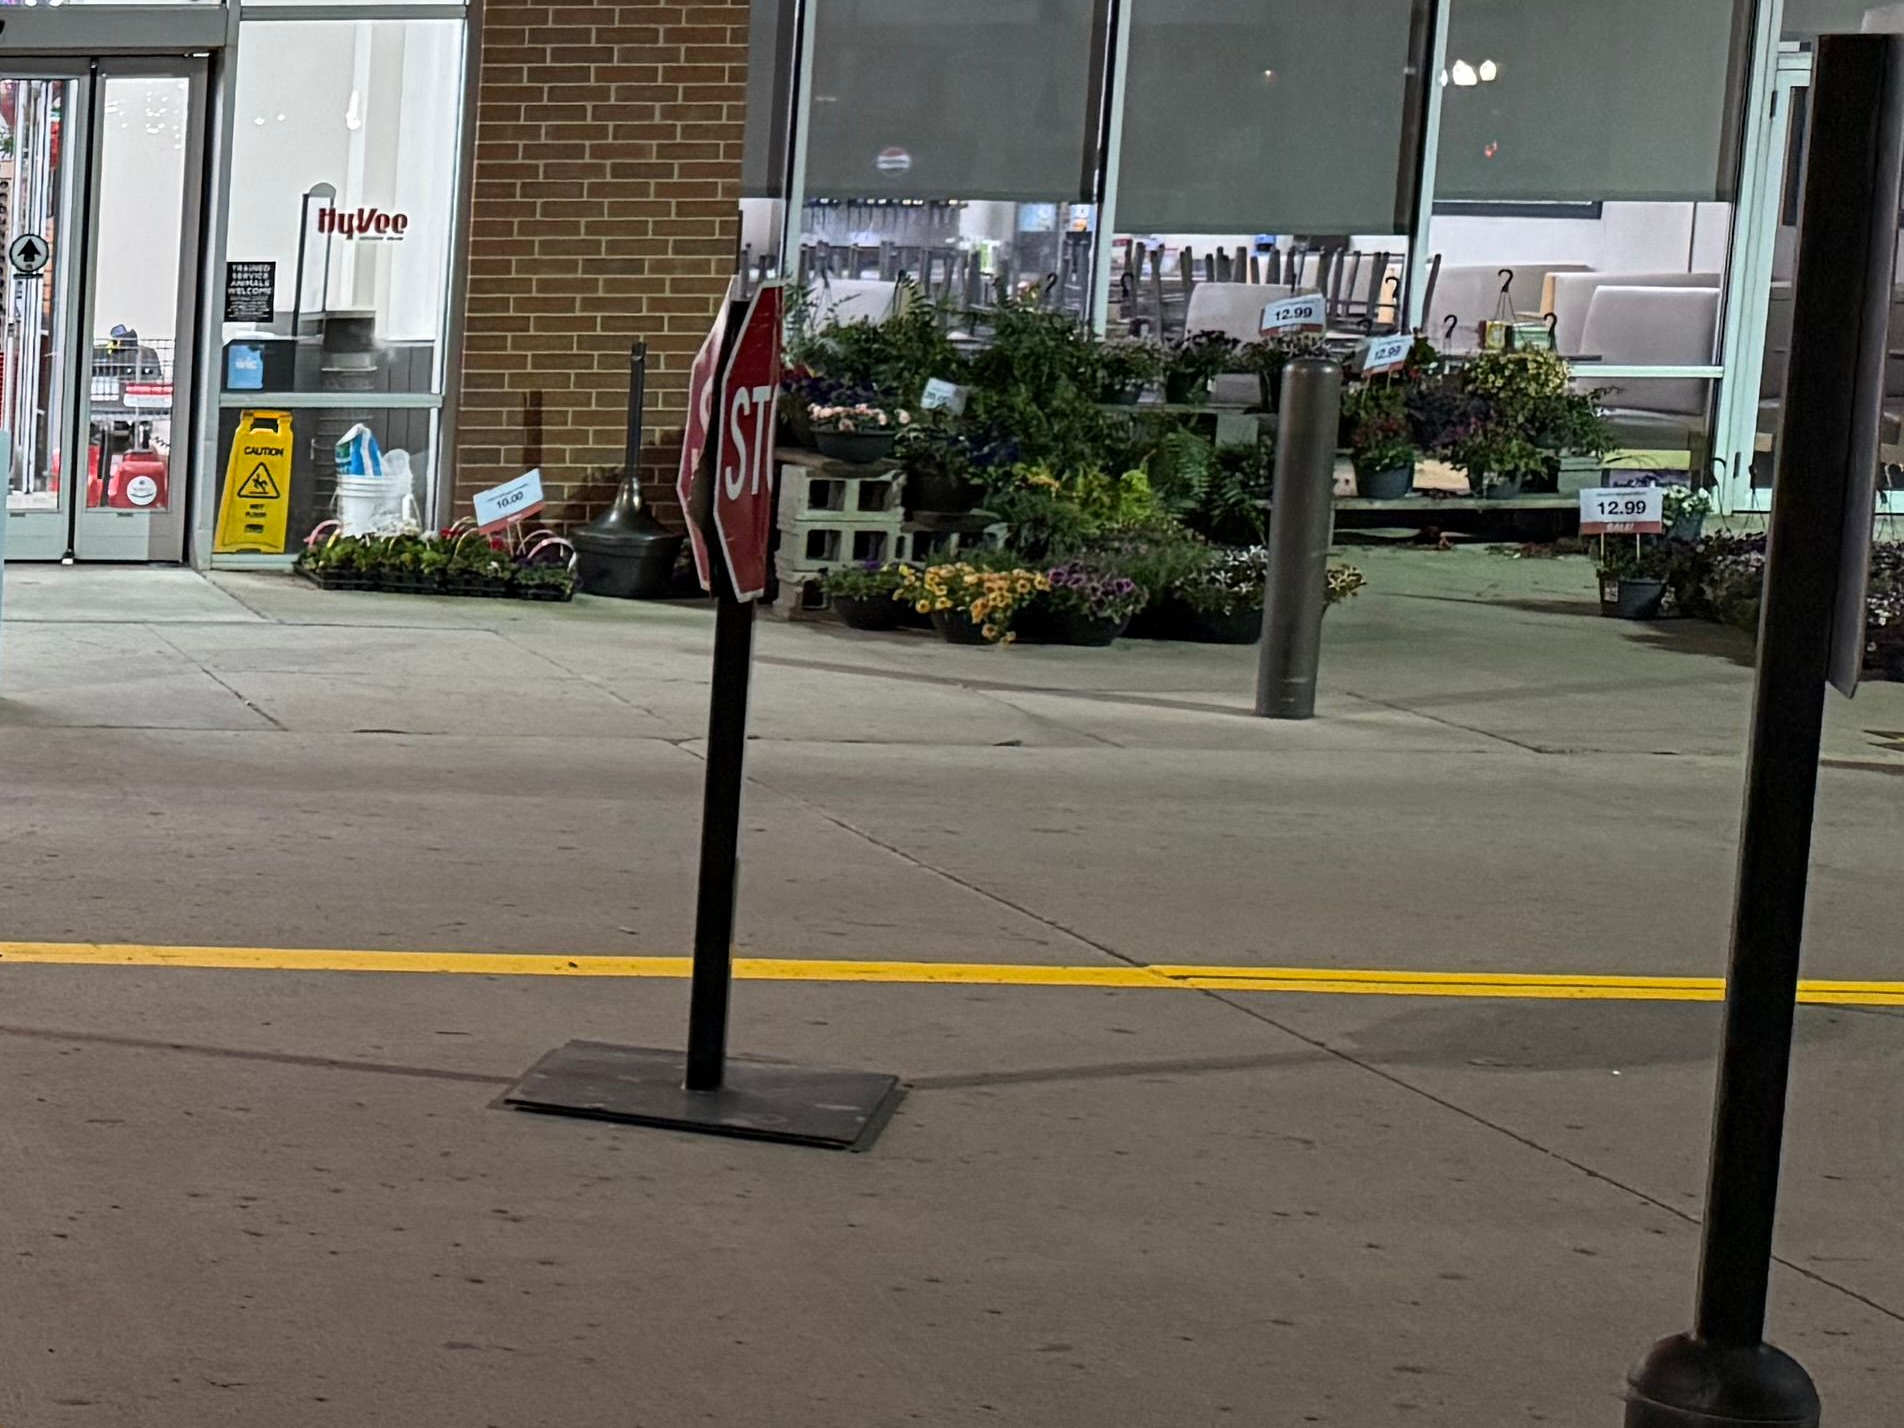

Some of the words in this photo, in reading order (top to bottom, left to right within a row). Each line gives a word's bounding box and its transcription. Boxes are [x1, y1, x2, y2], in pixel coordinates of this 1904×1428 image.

[1275, 306, 1313, 321] 12.99
[1374, 345, 1401, 361] 12.99
[243, 445, 285, 457] CAUTION
[1597, 500, 1647, 515] 12.99
